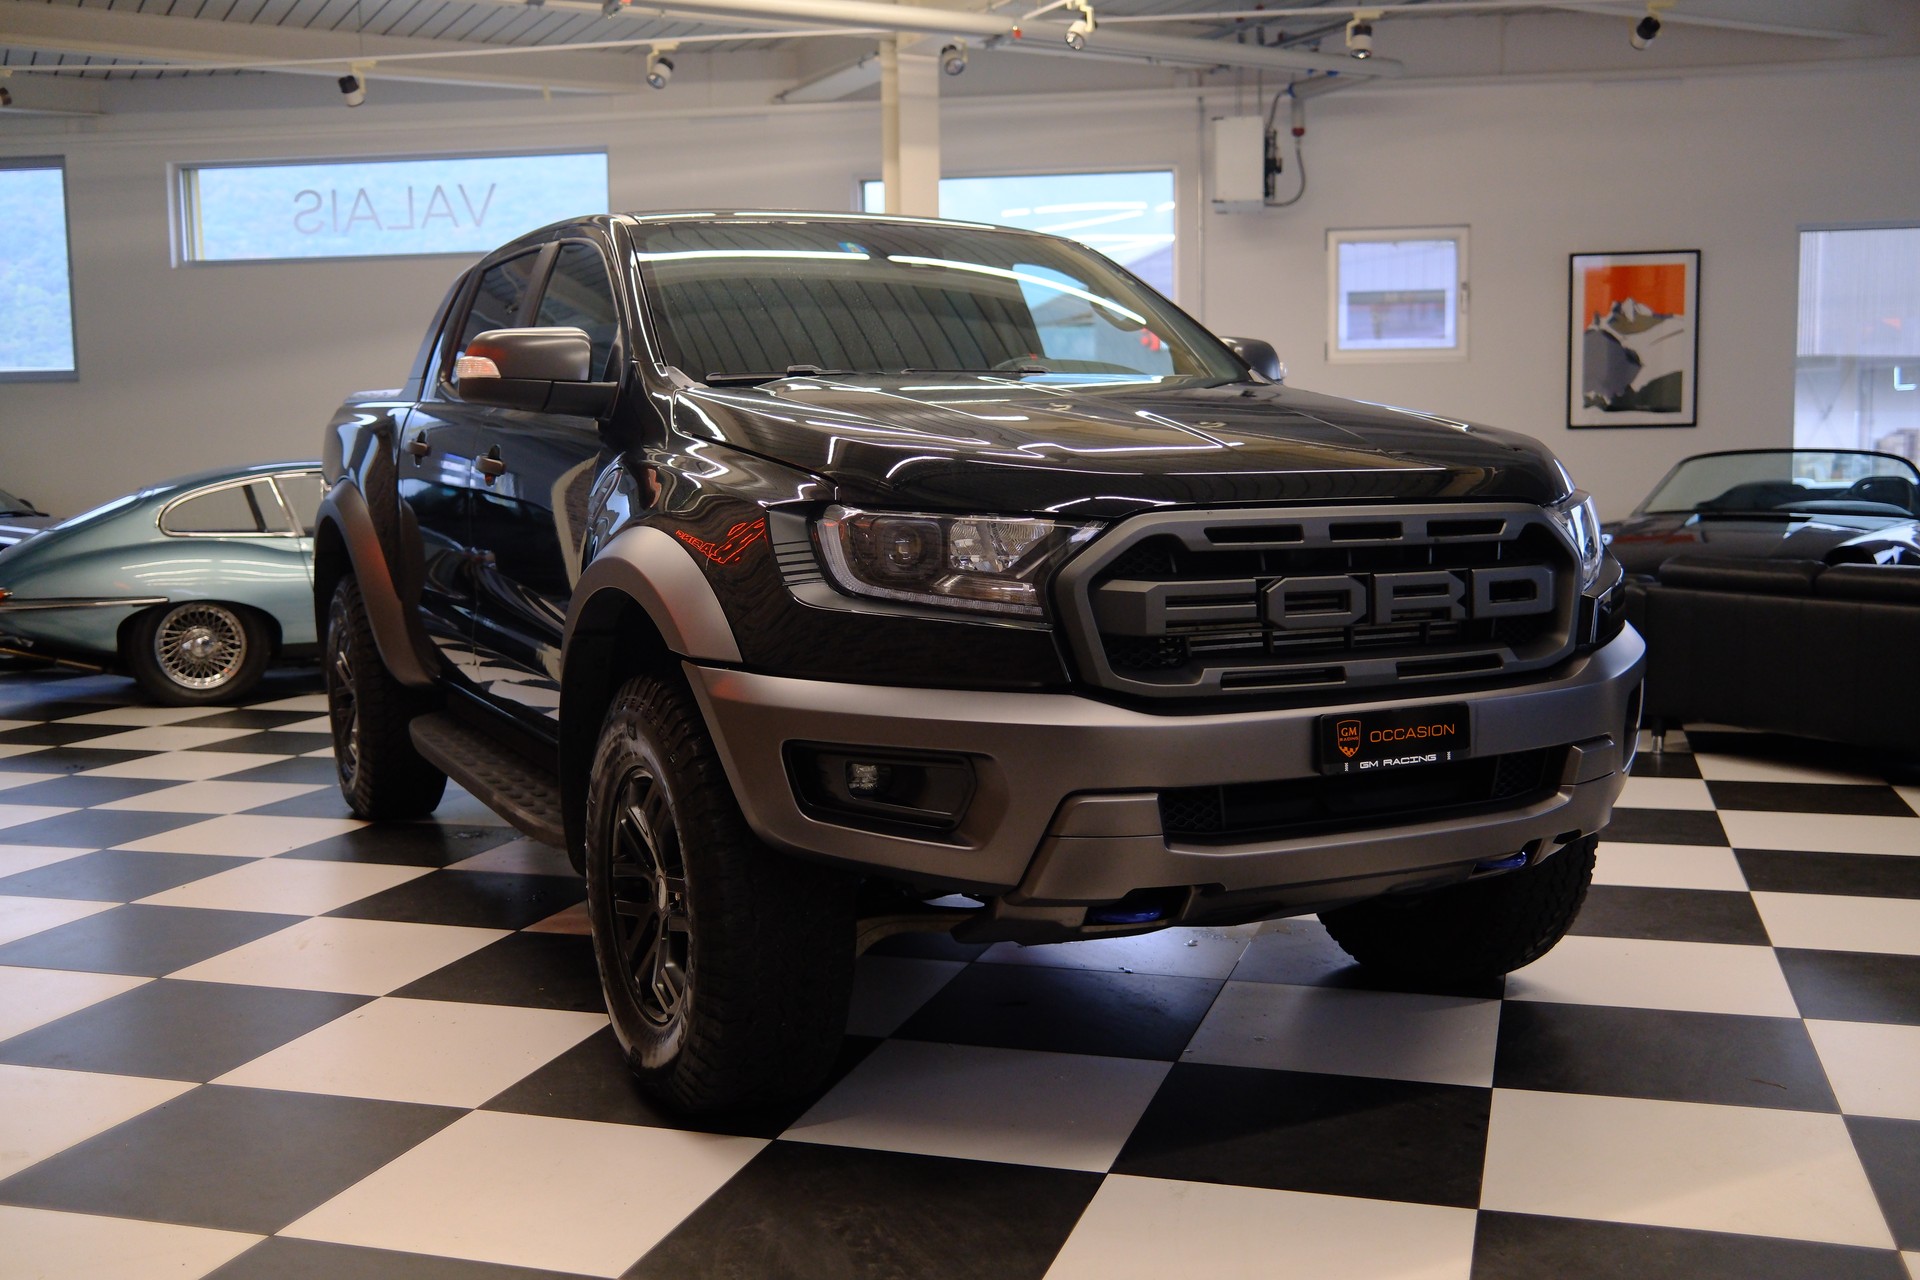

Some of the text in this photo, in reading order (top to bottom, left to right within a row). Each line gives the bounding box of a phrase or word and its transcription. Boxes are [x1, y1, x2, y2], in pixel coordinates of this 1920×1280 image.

[1099, 564, 1557, 637] FORD
[1340, 726, 1358, 737] GM
[1369, 723, 1456, 743] OCCASION
[1359, 753, 1437, 769] GM RACING
